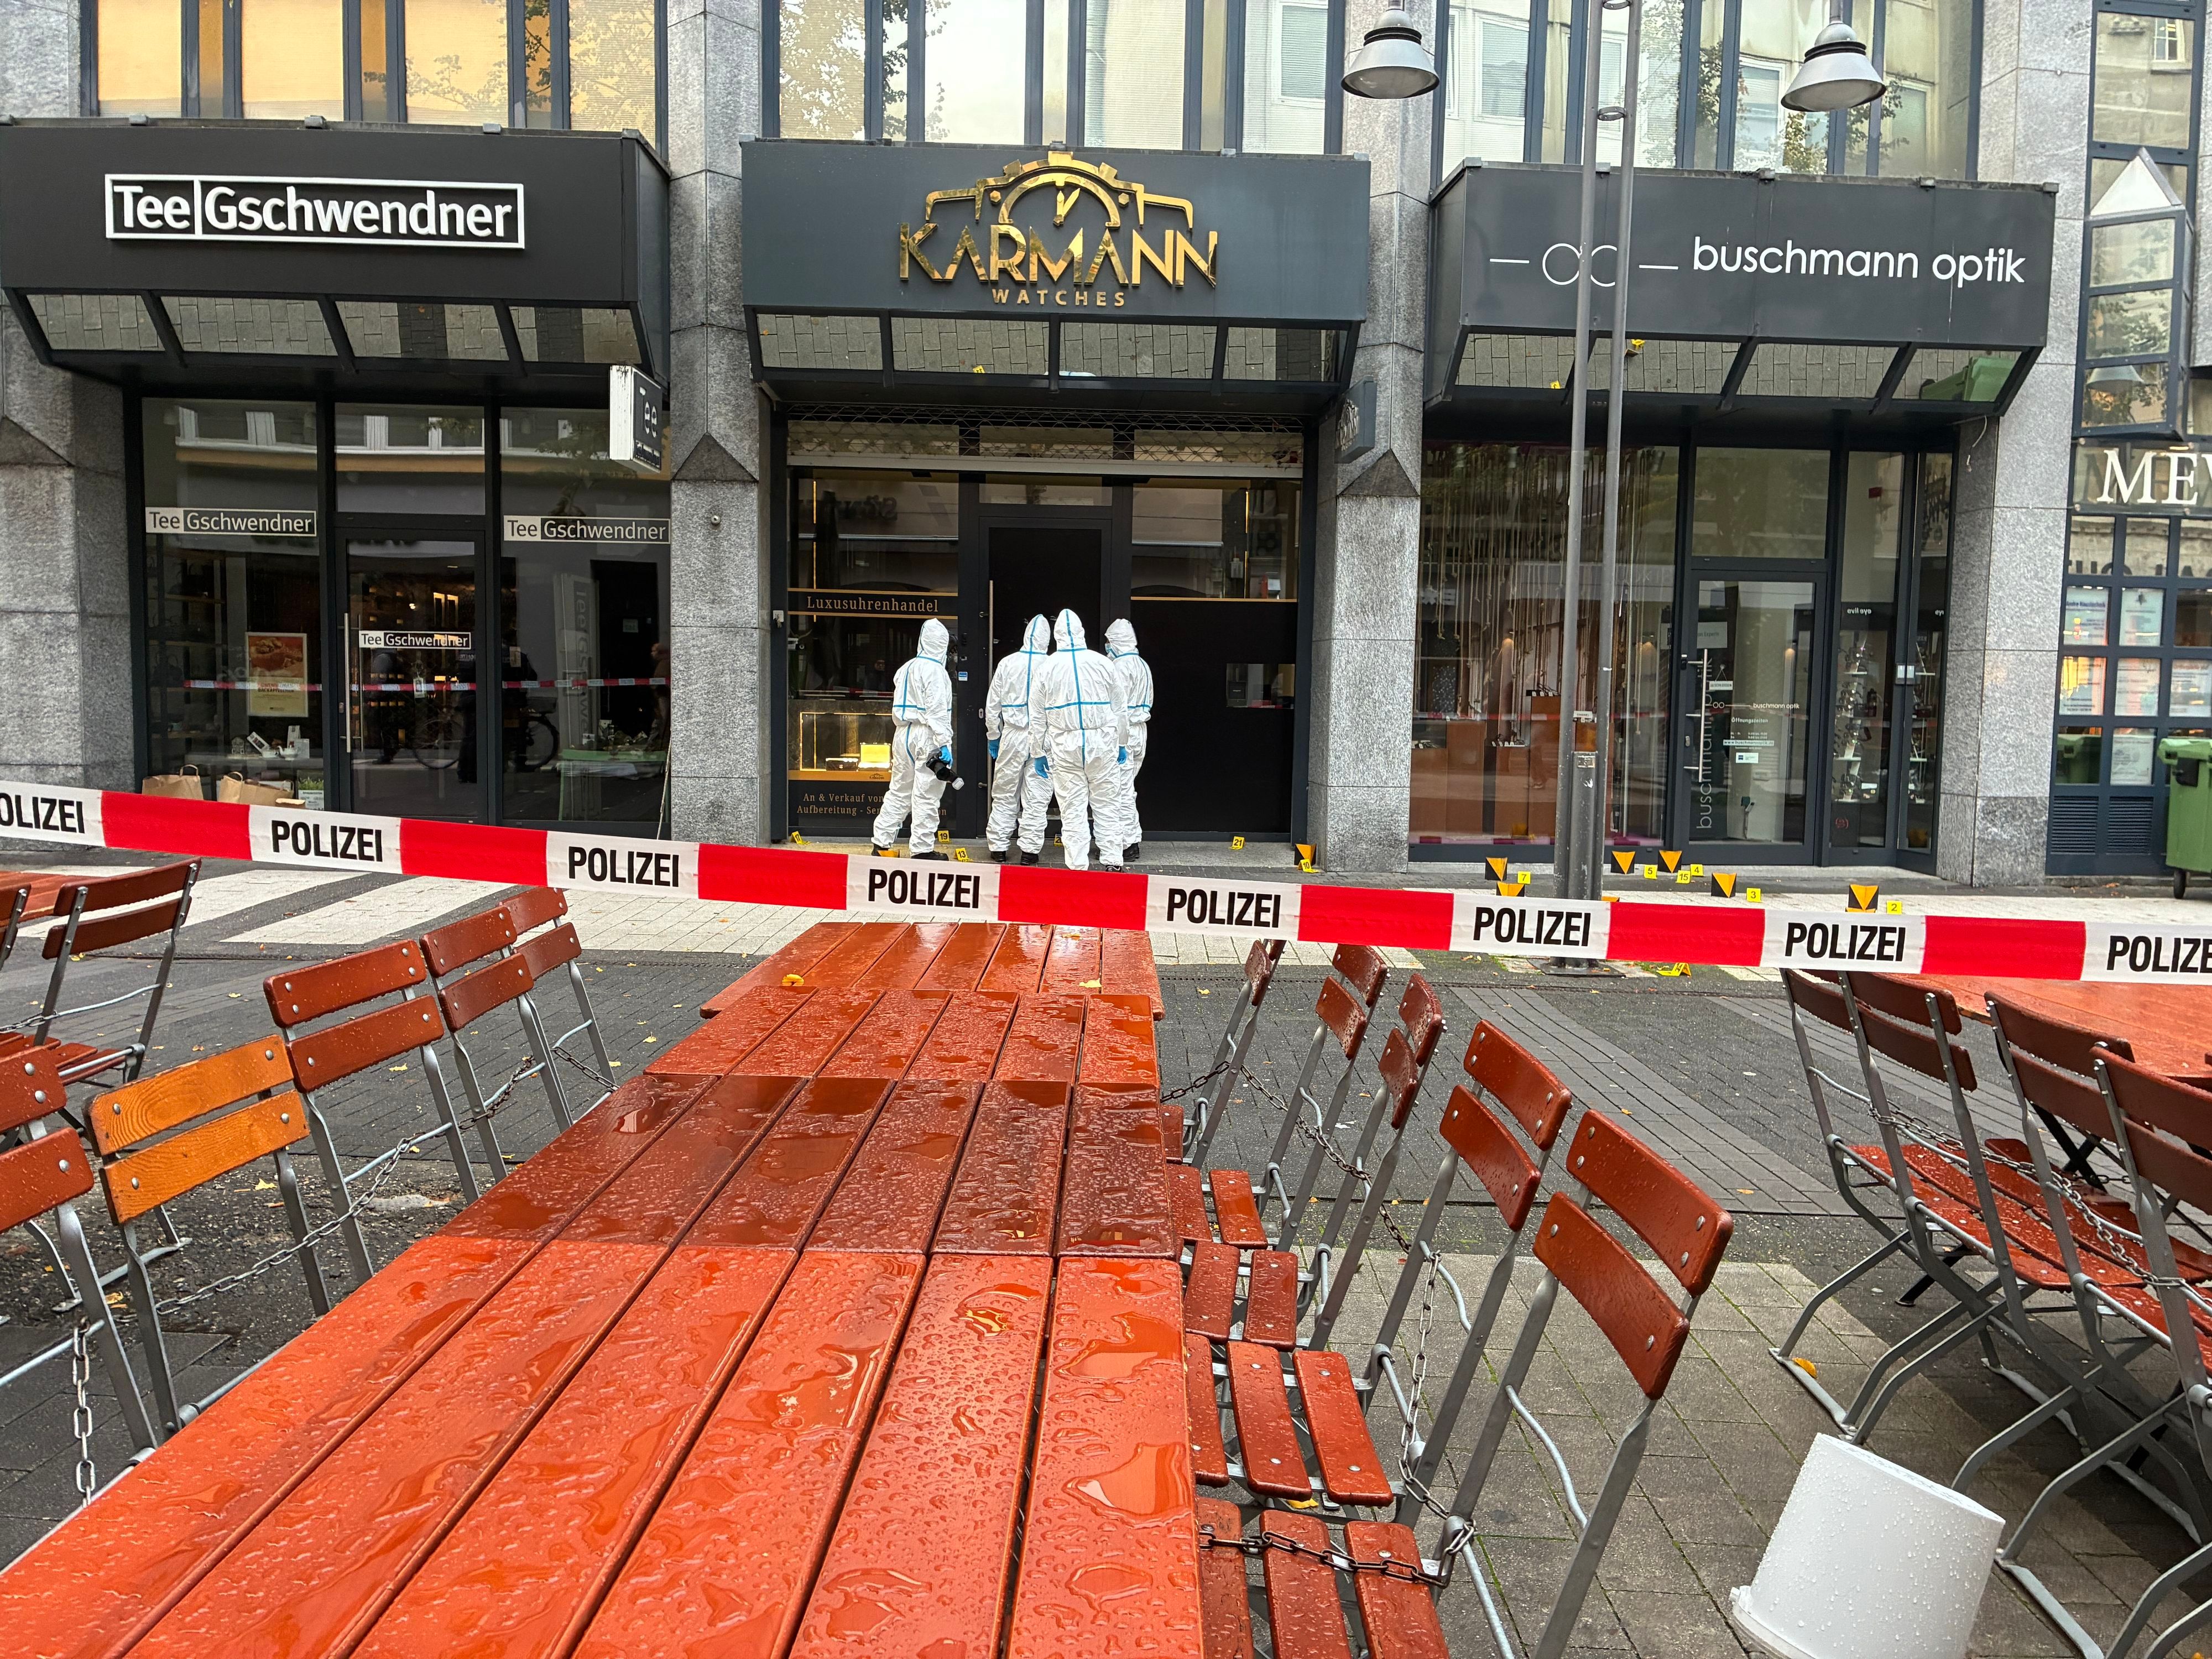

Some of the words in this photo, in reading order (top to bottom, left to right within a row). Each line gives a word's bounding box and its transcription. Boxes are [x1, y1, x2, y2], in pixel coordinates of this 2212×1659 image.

[114, 186, 190, 229] Tee
[205, 186, 512, 237] Gschwendner
[900, 222, 1217, 288] KARMANN
[1693, 236, 1918, 278] buschmann
[1932, 248, 2026, 288] optik
[992, 289, 1125, 306] WATCHES
[639, 387, 657, 437] Tee
[149, 512, 180, 529] Tee
[186, 512, 312, 532] Gschwendner
[508, 520, 537, 536] Tee
[544, 520, 666, 539] Gschwendner
[807, 596, 938, 612] Luxusuhrenhandel
[361, 633, 382, 645] Tee
[386, 634, 468, 646] Gschwendner
[0, 792, 85, 834] OLIZEI
[797, 805, 857, 816] Aufbereitung
[804, 793, 815, 801] An
[819, 794, 825, 802] &
[829, 794, 865, 802] Verkauf
[272, 820, 383, 862] POLIZEI
[568, 846, 679, 888] POLIZEI
[1679, 873, 1688, 881] 15
[868, 869, 980, 909] POLIZEI
[1167, 888, 1281, 928] POLIZEI
[1891, 903, 1897, 911] 2
[1473, 906, 1591, 947] POLIZEI
[1785, 922, 1906, 962] POLIZEI
